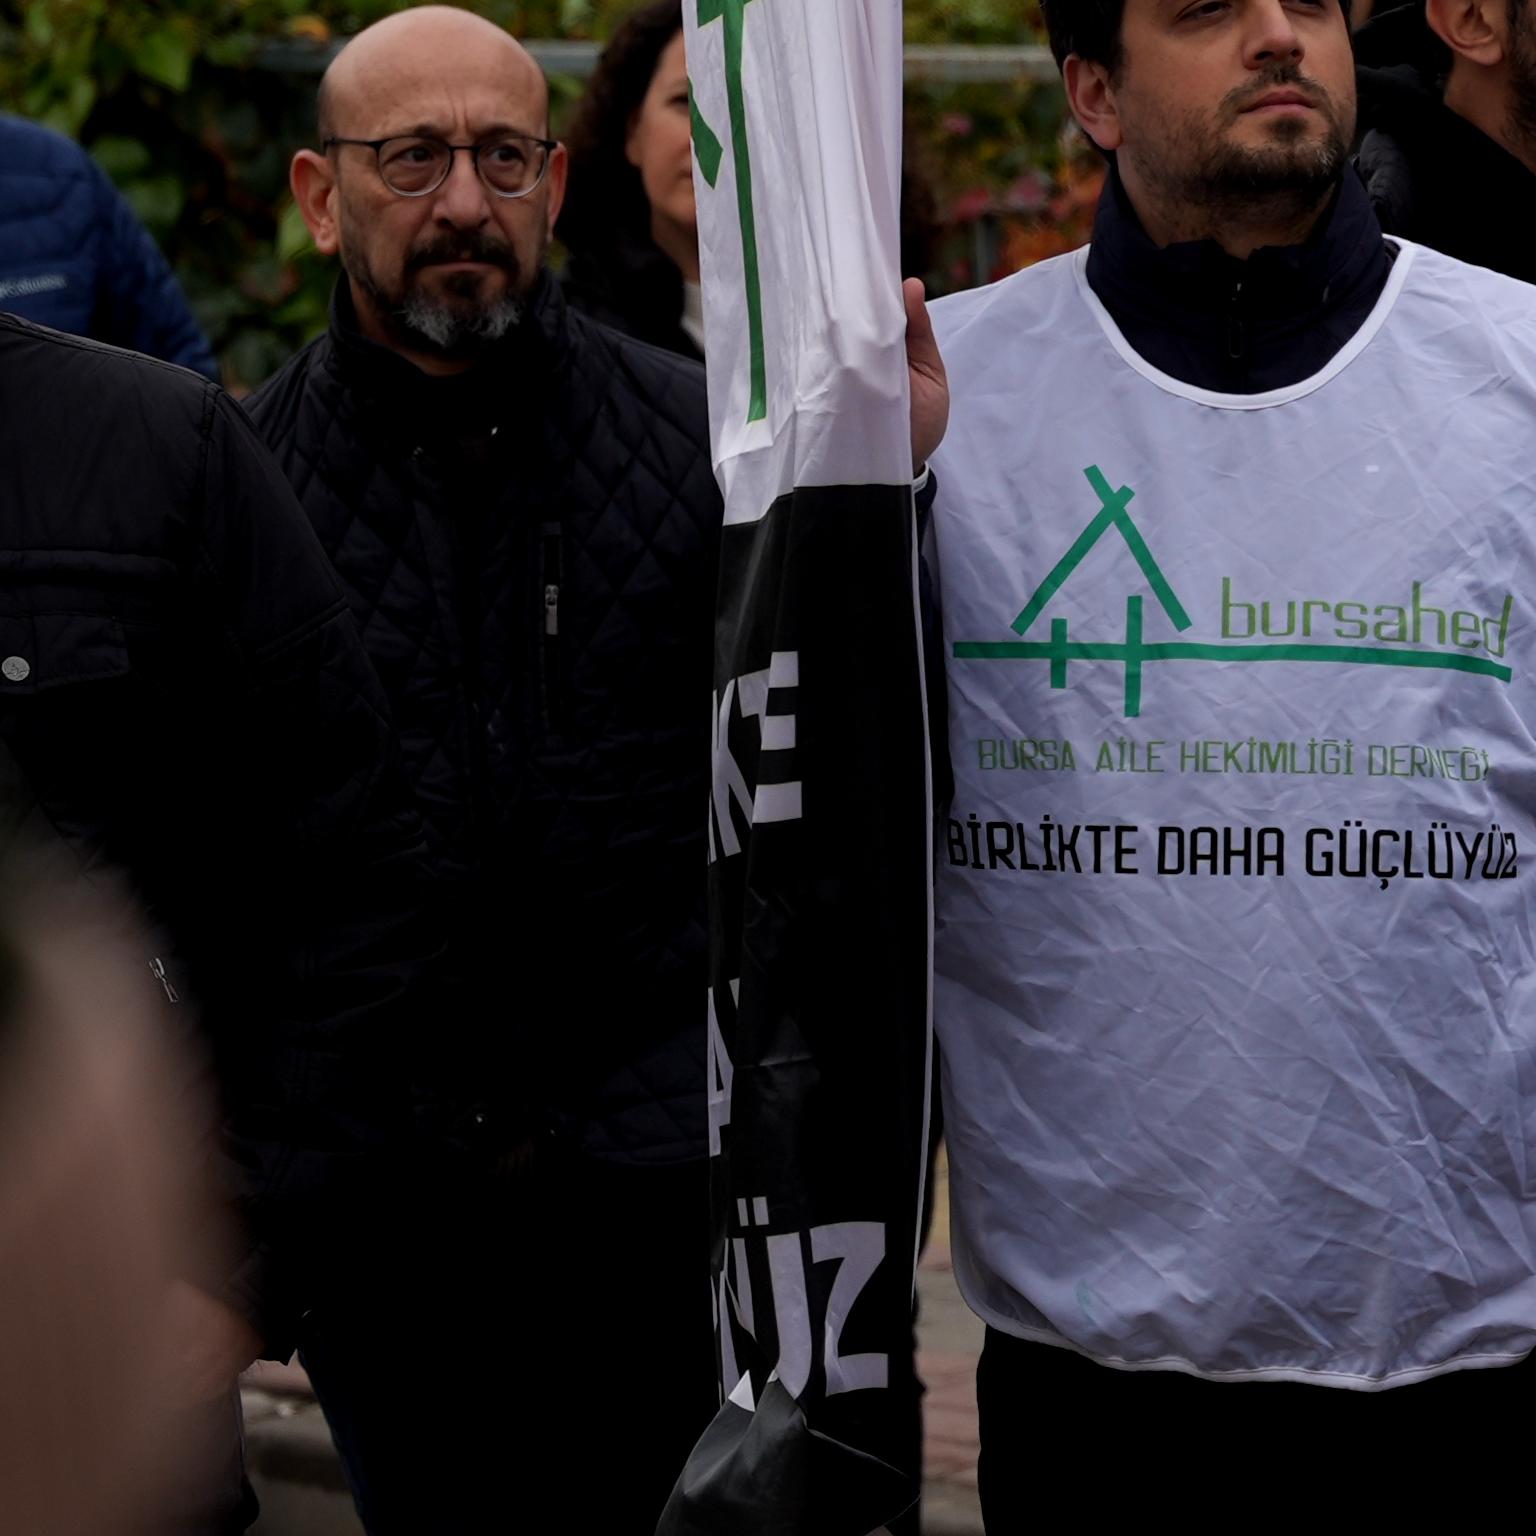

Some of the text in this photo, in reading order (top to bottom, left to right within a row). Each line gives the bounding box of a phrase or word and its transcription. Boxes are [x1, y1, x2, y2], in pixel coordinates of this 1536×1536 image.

[1221, 576, 1513, 659] bursahed
[978, 736, 1490, 782] BURSA AİLE HEKİMLİĞİ DERNEĞİ
[947, 813, 1518, 891] BİRLİKTE DAHA GÜÇLÜYÜZ
